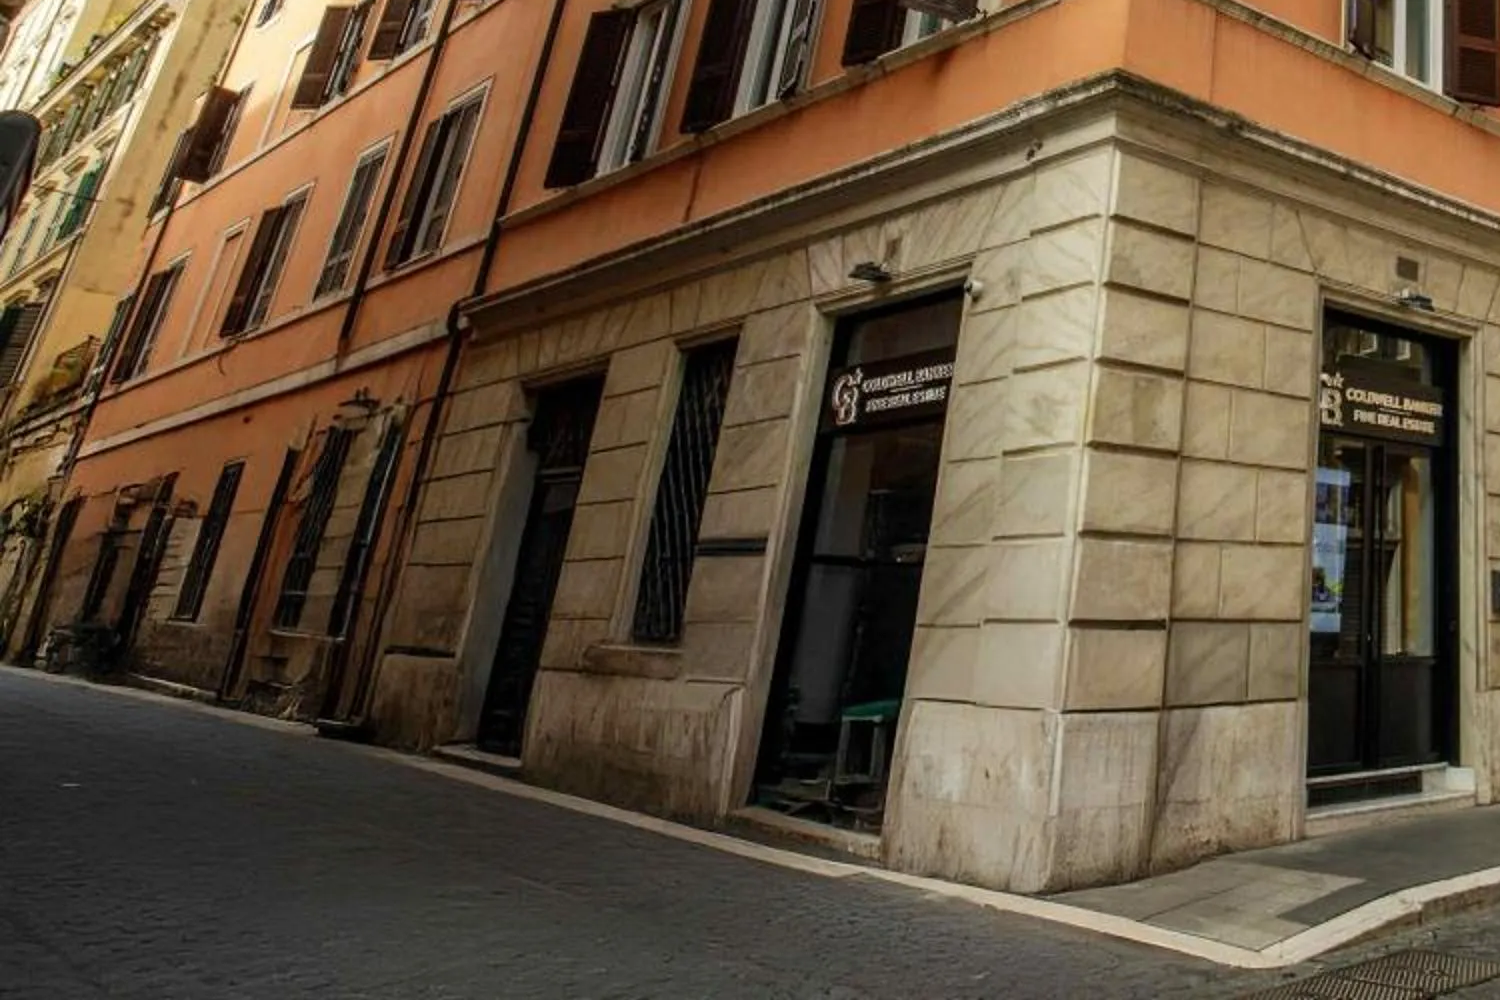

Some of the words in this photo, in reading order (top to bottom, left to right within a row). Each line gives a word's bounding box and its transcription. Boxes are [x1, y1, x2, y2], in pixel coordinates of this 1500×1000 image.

[1345, 387, 1403, 409] COLDWELL
[1403, 397, 1443, 416] BANKER
[1353, 409, 1377, 424] FINE
[1377, 413, 1403, 428] REAL
[1402, 417, 1435, 434] ESTATE
